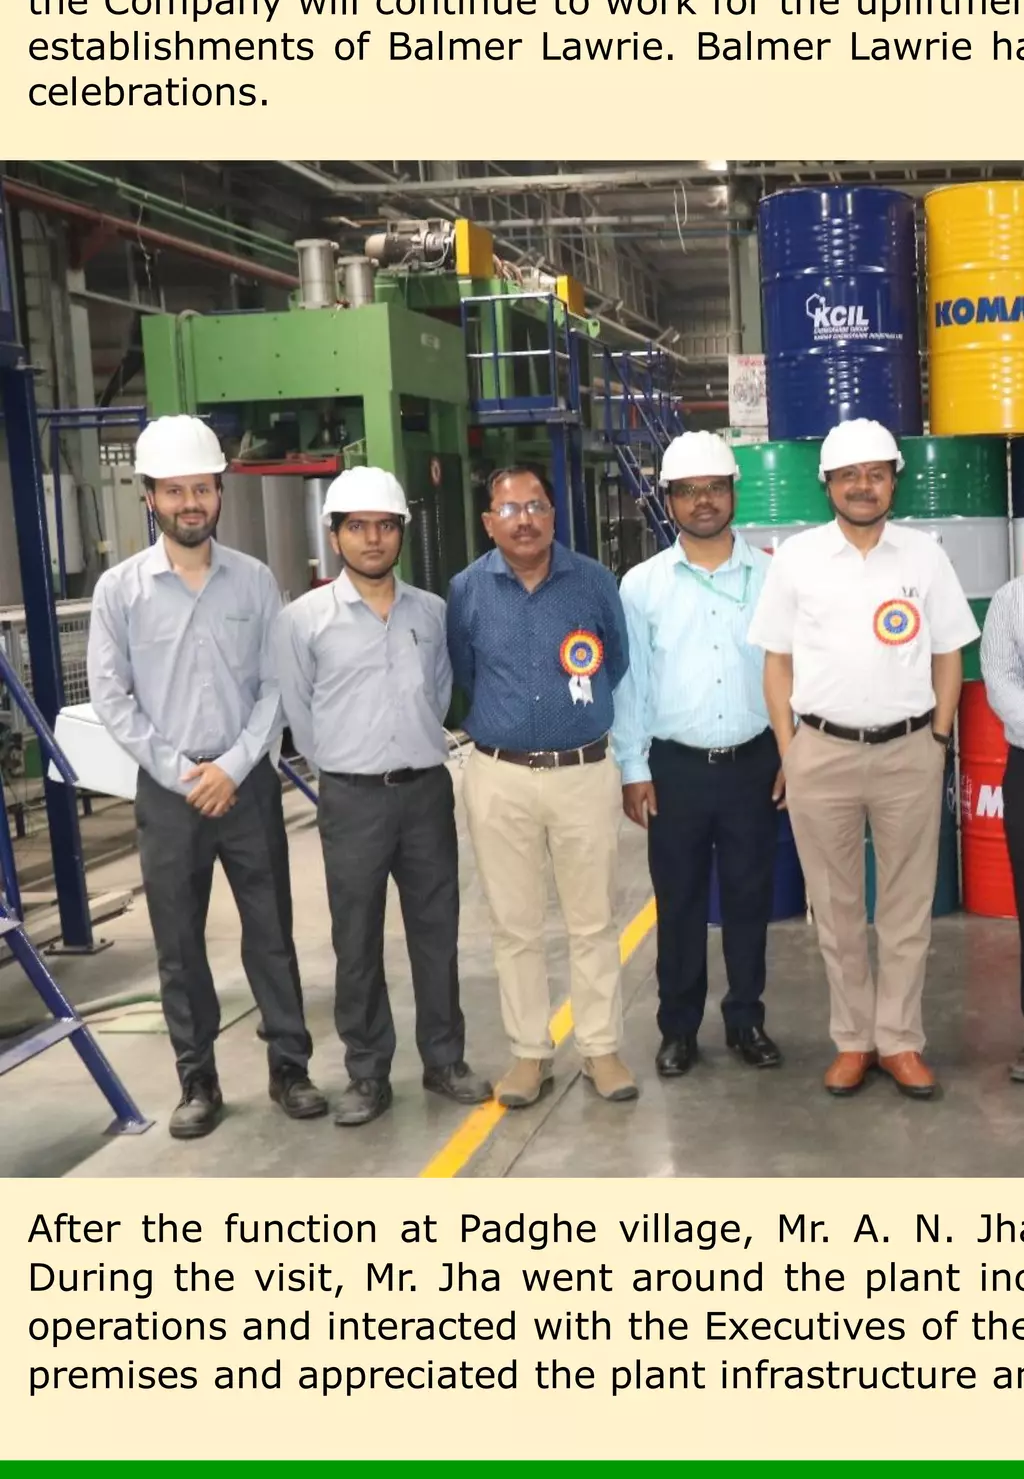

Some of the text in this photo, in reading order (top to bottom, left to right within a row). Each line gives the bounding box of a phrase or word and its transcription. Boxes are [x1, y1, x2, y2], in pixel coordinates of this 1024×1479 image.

[29, 76, 267, 106] celebrations.
[813, 305, 869, 327] KCIL
[28, 1213, 121, 1243] After
[142, 1213, 201, 1243] the
[225, 1213, 375, 1243] function
[401, 1215, 437, 1243] at
[462, 1213, 596, 1250] Padghe
[619, 1213, 752, 1250] village,
[780, 1214, 828, 1242] Mr.
[854, 1214, 888, 1242] A.
[917, 1214, 952, 1242] N.
[31, 1360, 197, 1396] premises
[215, 1359, 280, 1389] and
[299, 1359, 516, 1396] appreciated
[535, 1359, 594, 1389] the
[613, 1359, 705, 1396] plant
[722, 1359, 976, 1389] infrastructure
